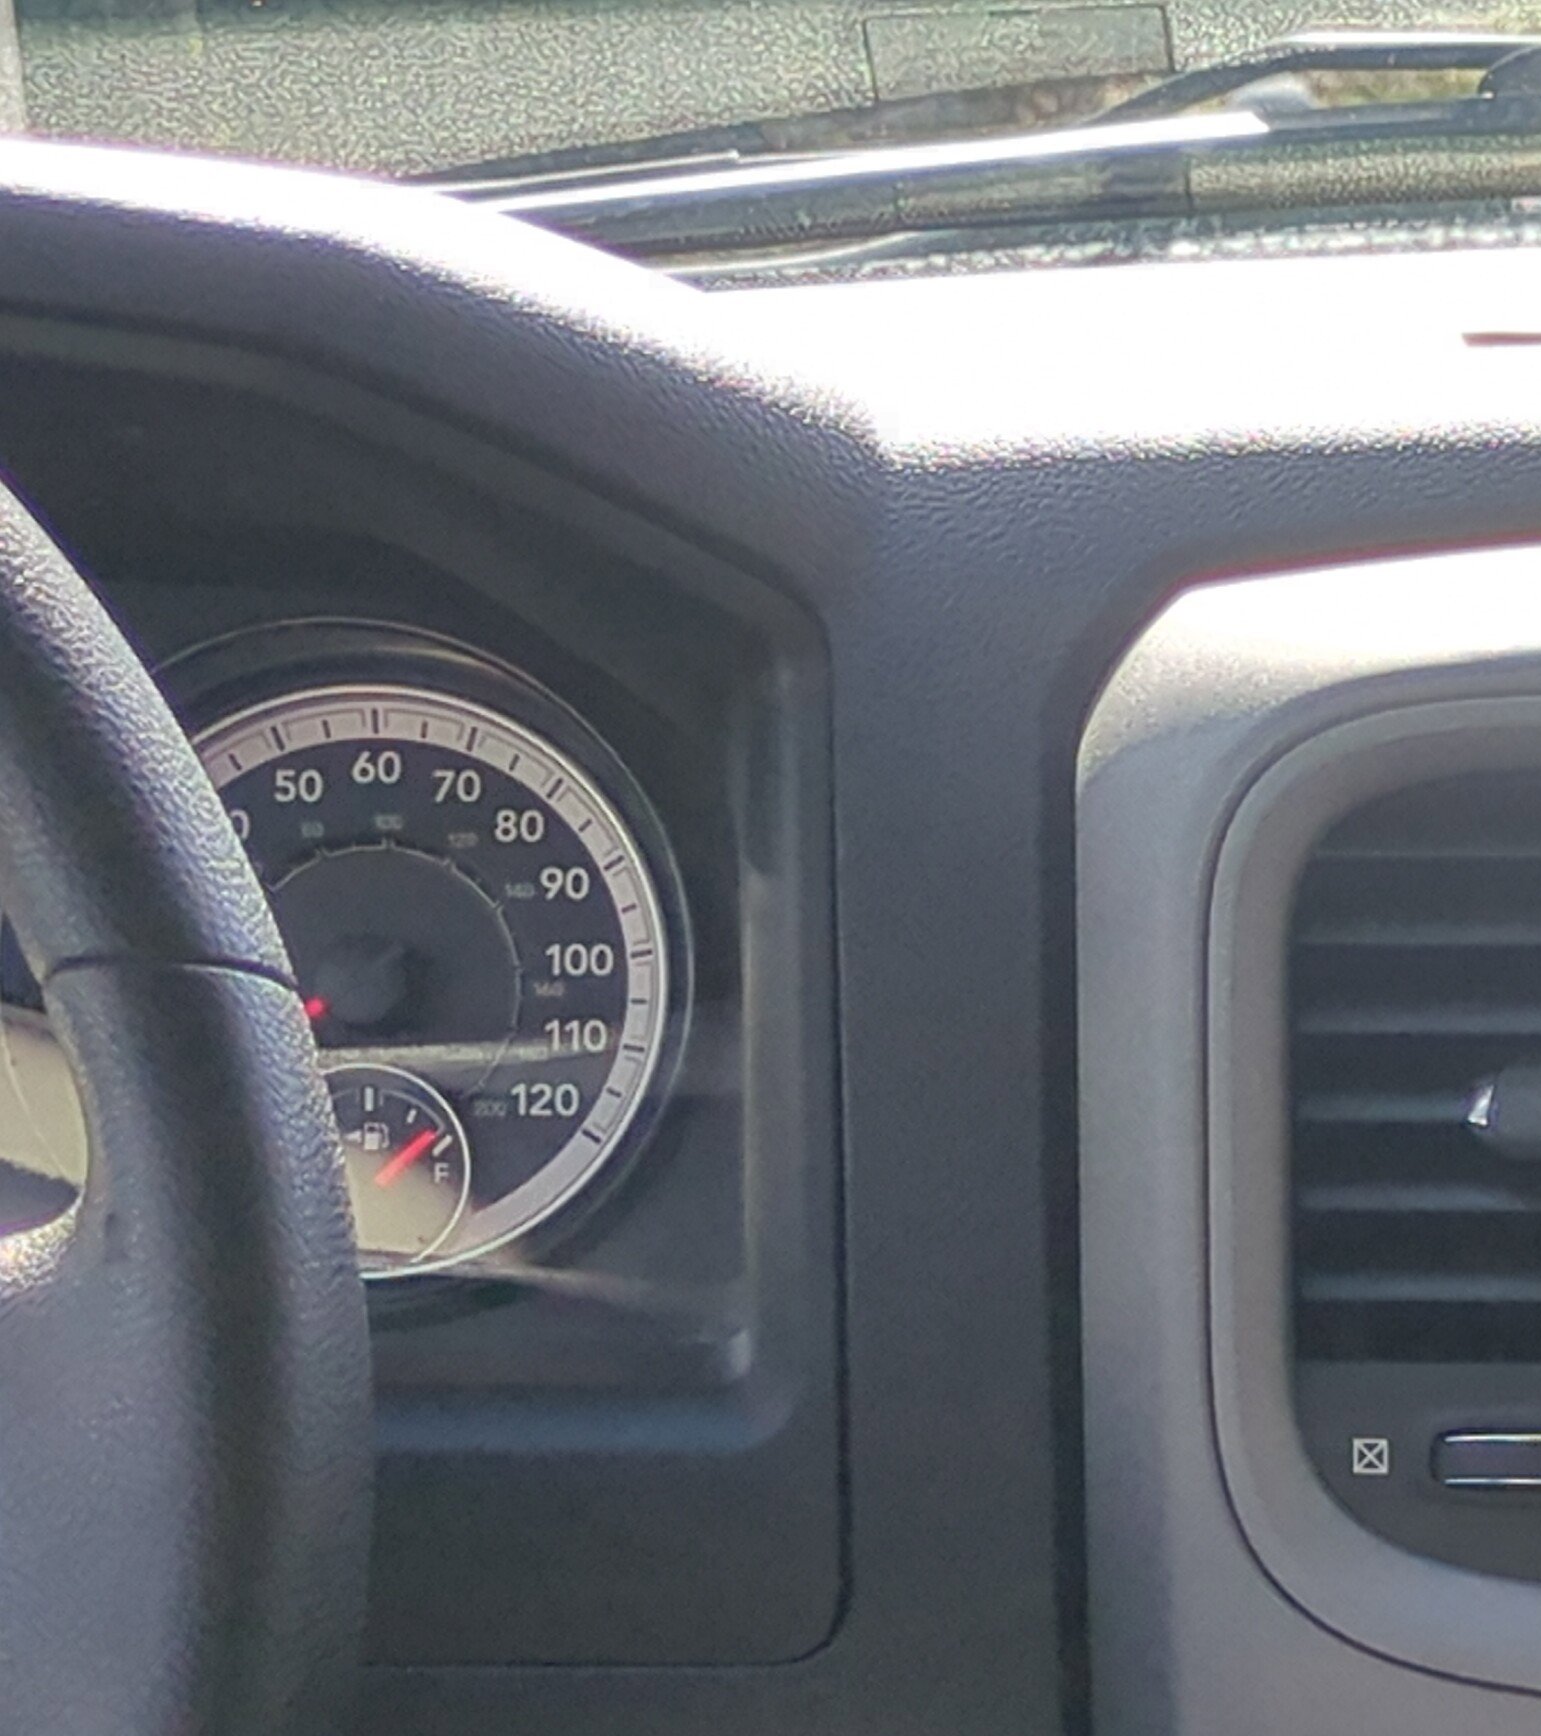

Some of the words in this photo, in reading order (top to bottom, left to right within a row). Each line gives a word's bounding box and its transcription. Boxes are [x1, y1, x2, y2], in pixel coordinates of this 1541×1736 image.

[351, 751, 401, 784] 60
[274, 770, 323, 802] 50
[432, 770, 482, 802] 70
[494, 810, 545, 843] 80
[539, 867, 590, 900] 90
[545, 944, 614, 976] 100
[545, 1019, 608, 1051] 110
[510, 1083, 580, 1117] 120
[434, 1162, 450, 1183] F
